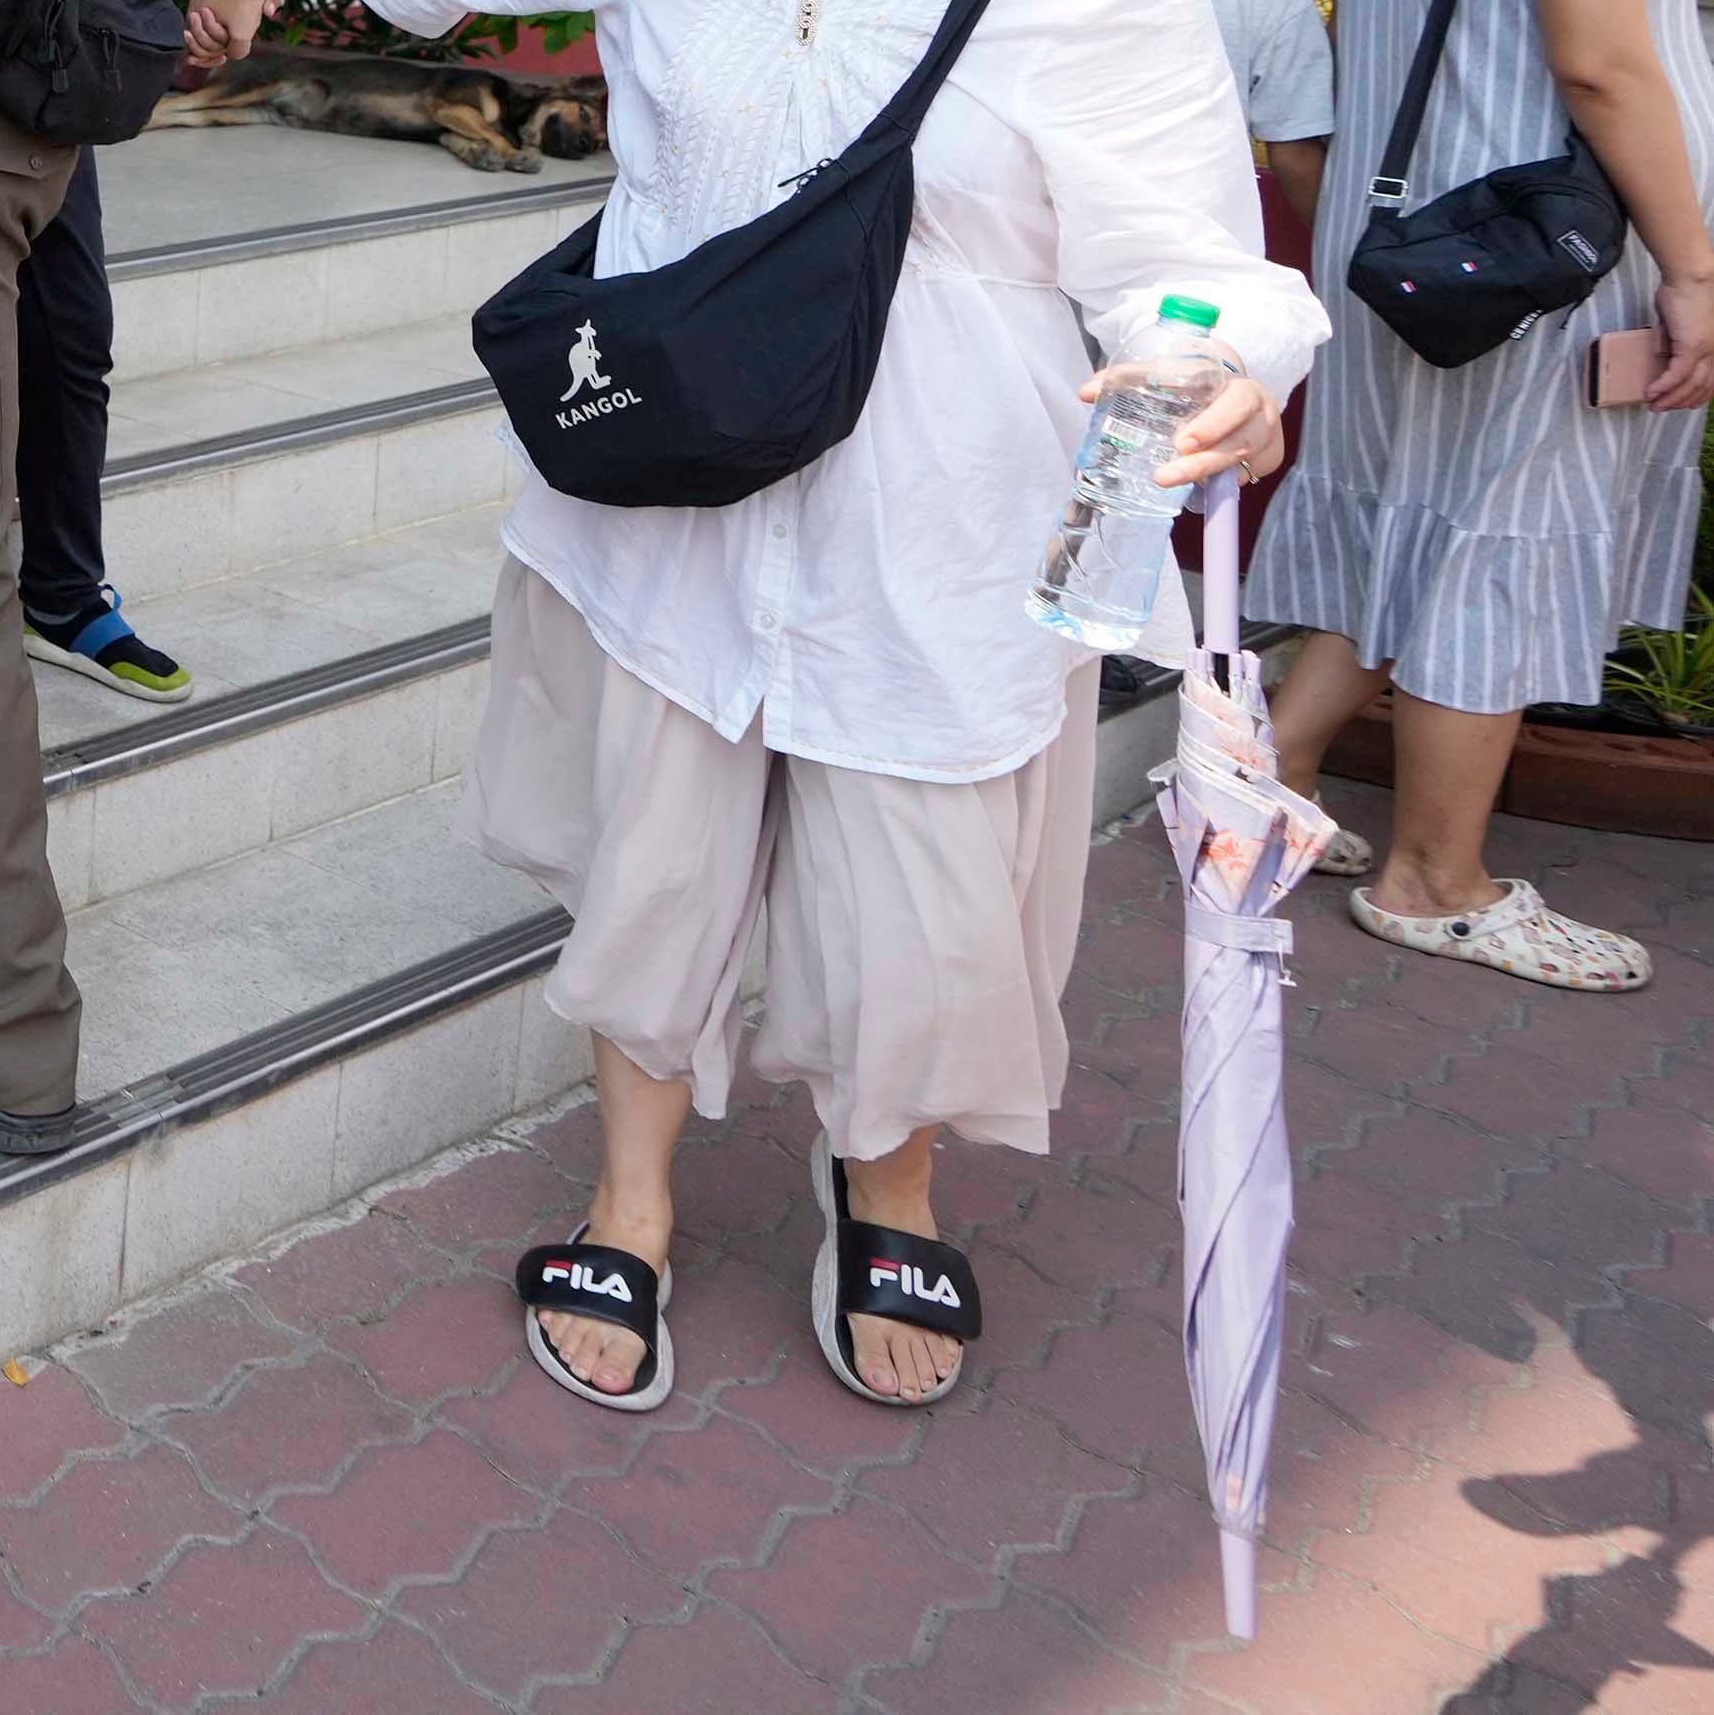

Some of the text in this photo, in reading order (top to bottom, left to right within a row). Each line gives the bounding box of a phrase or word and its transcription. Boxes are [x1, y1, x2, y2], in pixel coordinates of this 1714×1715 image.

[555, 388, 643, 429] KANGOL
[542, 1260, 633, 1303] FILA
[871, 1258, 961, 1308] FILA
